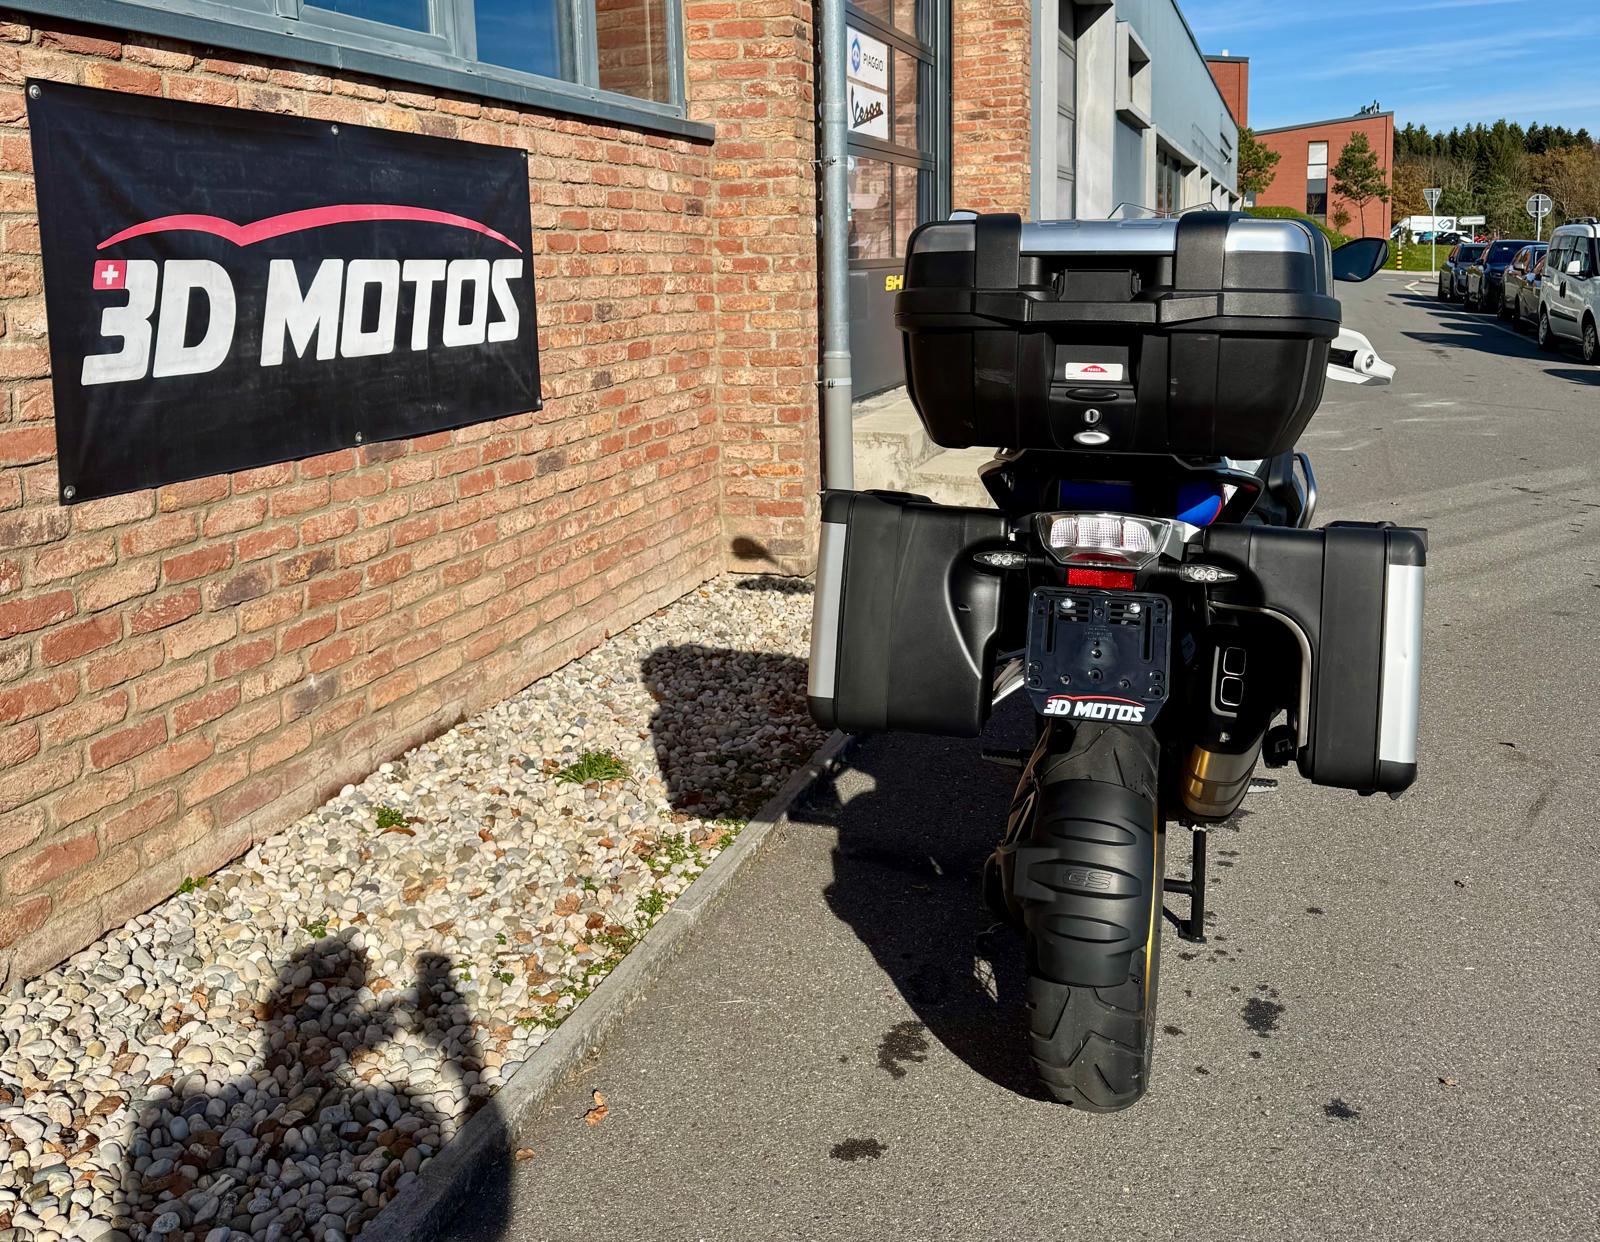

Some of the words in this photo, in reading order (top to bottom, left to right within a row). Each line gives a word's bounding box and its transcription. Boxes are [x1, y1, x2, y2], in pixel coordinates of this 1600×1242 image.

[862, 53, 884, 72] PIAGGIO
[851, 85, 884, 129] Vespa
[885, 275, 904, 291] SH
[81, 259, 237, 386] 3D
[260, 258, 524, 367] MOTOS
[1043, 698, 1072, 716] 3D
[1073, 701, 1146, 722] MOTOS
[1063, 868, 1113, 890] GS
